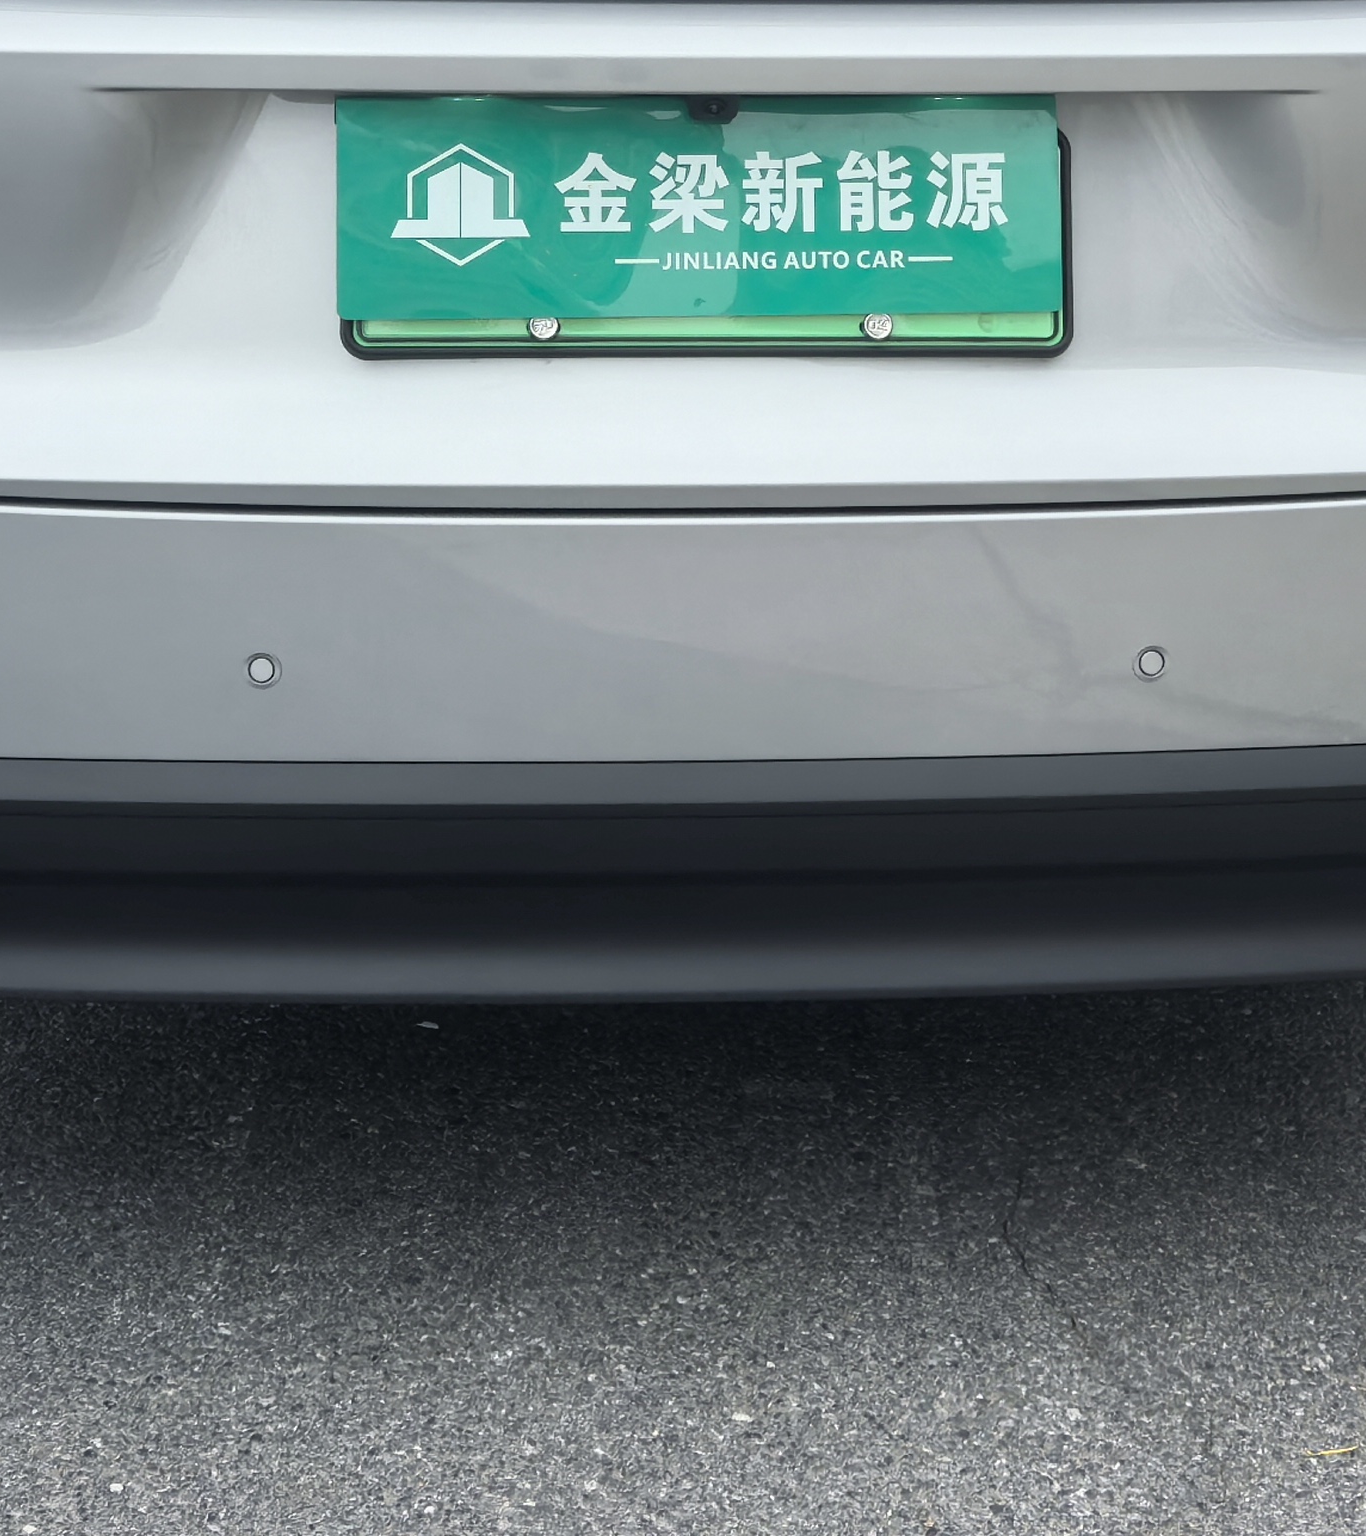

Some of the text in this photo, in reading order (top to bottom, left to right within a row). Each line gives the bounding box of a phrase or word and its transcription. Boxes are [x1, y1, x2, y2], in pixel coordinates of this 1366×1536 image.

[554, 150, 1009, 234] 金梁新能源
[662, 250, 906, 271] JINLIANG AUTO CAR
